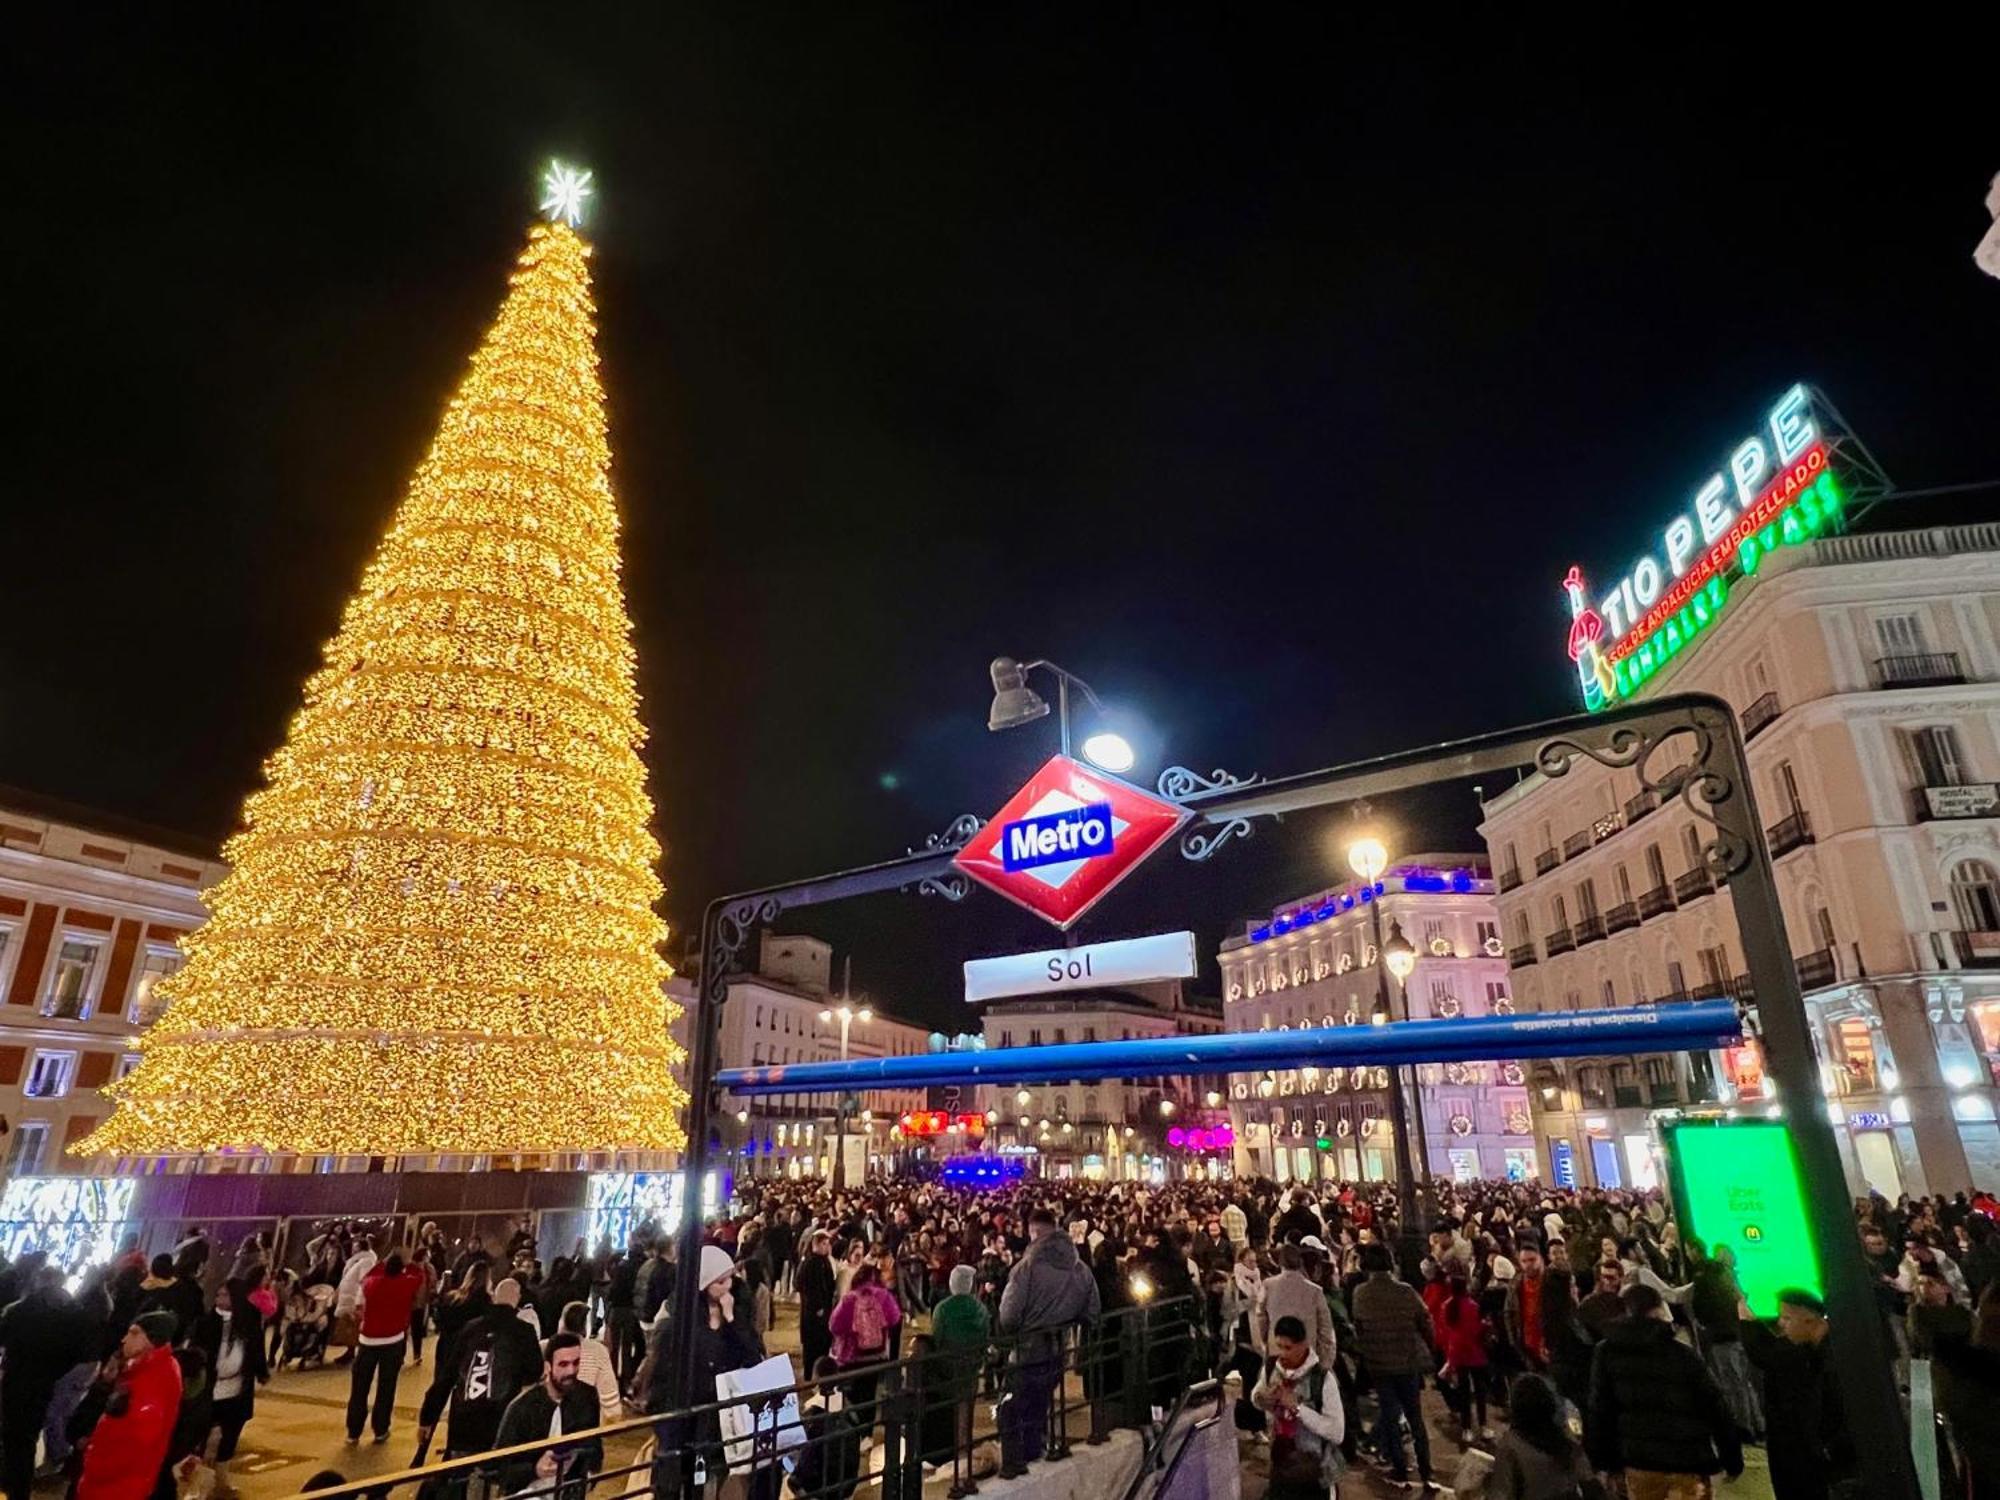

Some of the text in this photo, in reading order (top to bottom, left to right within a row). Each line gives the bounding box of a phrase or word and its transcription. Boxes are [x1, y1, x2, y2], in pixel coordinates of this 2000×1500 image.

[1601, 383, 1816, 638] TIO PEPE
[1609, 450, 1821, 665] SOL DE ANDALUCIA EMBOTELLADO
[1010, 818, 1105, 861] Metro
[1047, 954, 1092, 981] Sol
[1511, 1013, 1657, 1031] Disculpen las molestias
[1727, 1186, 1760, 1198] Uber
[1729, 1200, 1765, 1212] Eats
[469, 1351, 489, 1399] FILA
